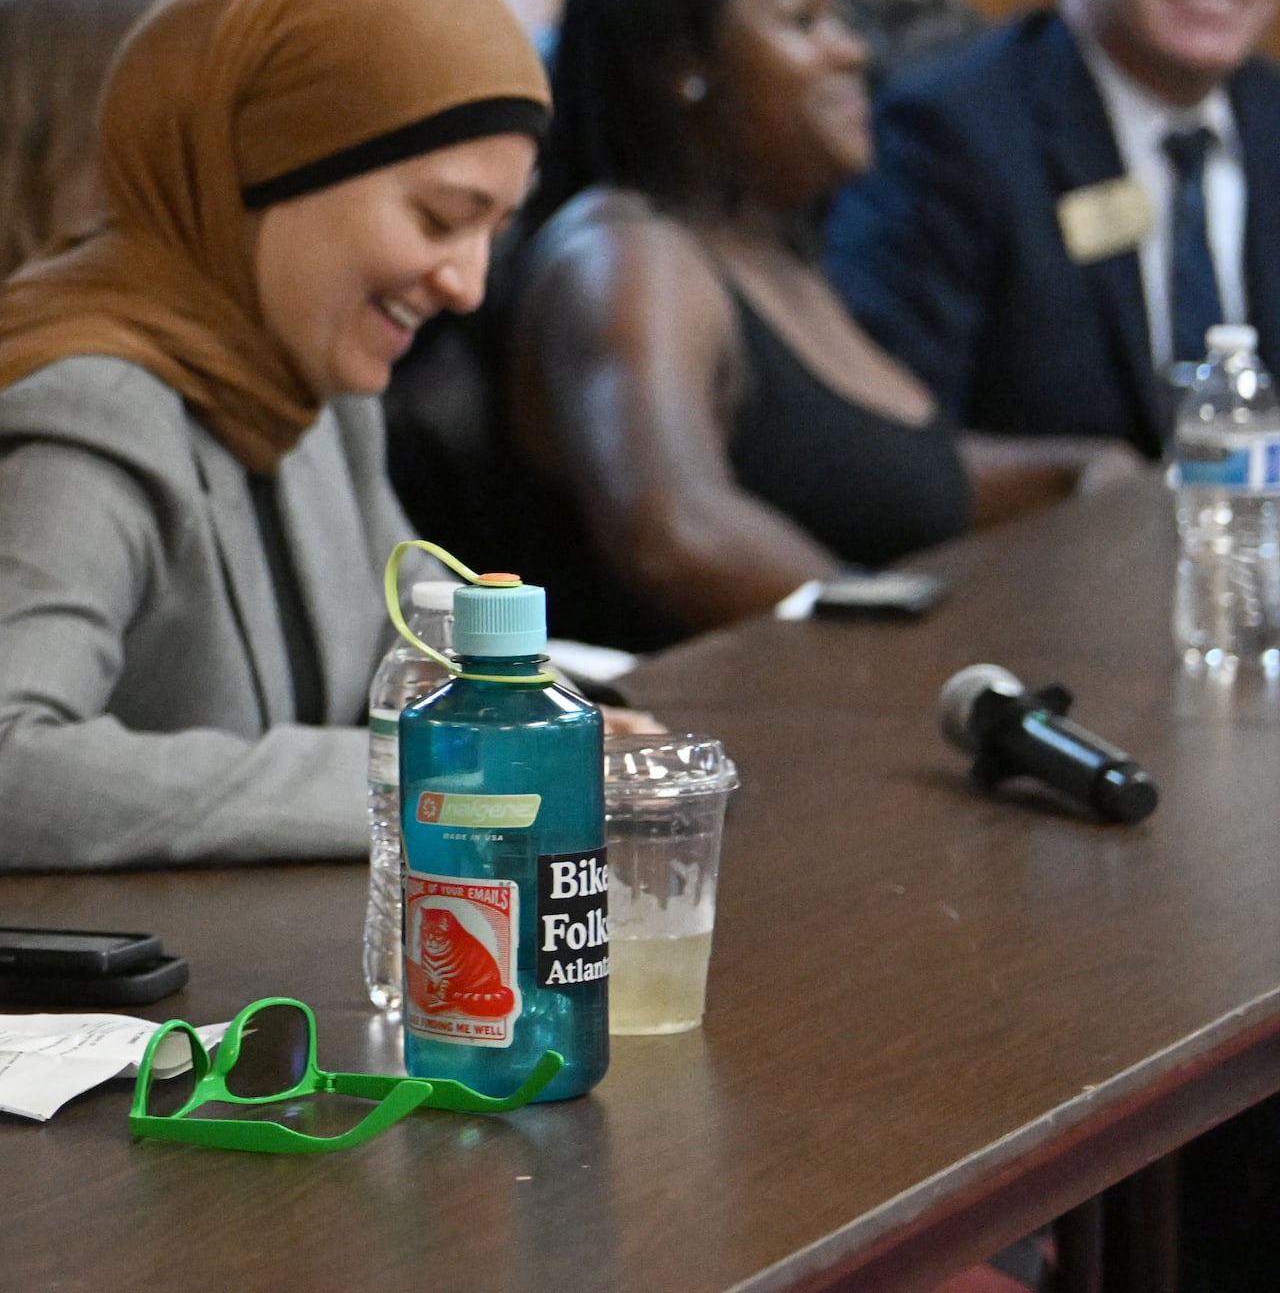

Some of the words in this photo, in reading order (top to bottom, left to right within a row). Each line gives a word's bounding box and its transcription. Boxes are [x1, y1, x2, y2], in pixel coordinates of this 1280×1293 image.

[443, 833, 467, 841] MADE
[484, 834, 504, 842] USA
[467, 887, 509, 910] EMAILS
[545, 957, 609, 985] Atlant
[456, 1023, 471, 1034] ME
[474, 1025, 504, 1036] WELL
